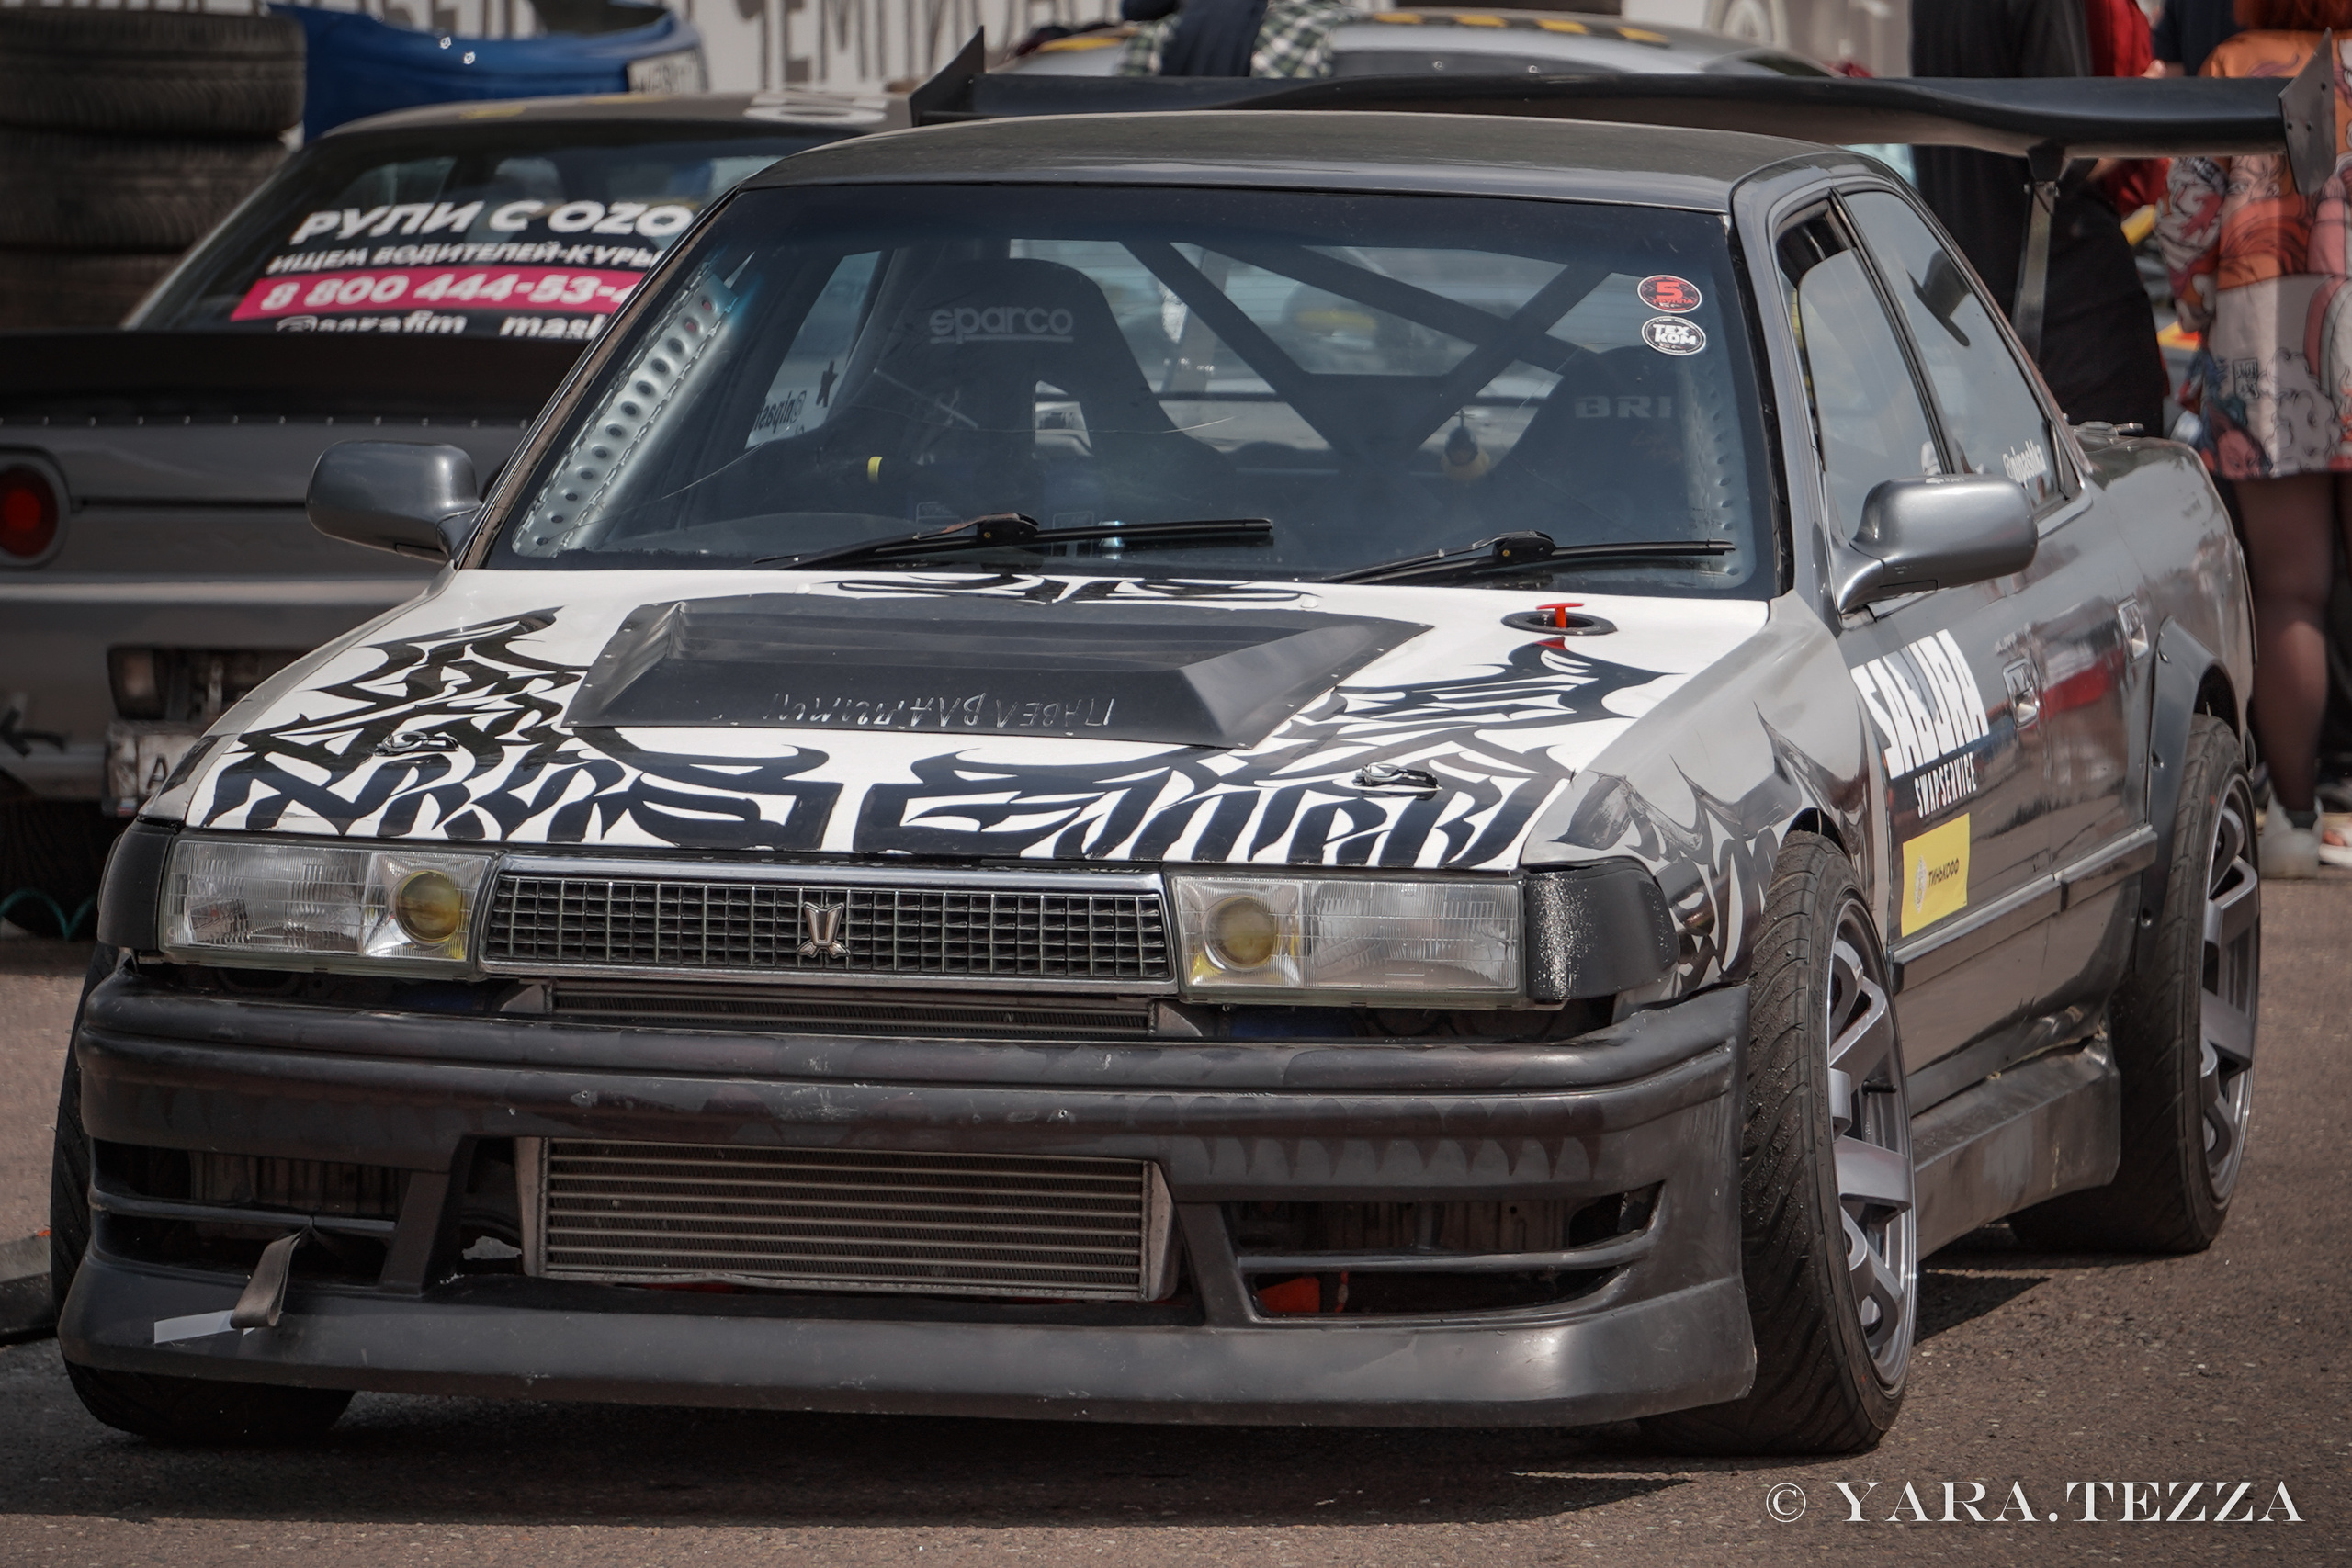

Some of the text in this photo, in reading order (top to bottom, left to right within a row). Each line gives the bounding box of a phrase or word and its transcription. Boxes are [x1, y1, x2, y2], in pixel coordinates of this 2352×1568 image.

[289, 201, 484, 245] РУЛИ
[266, 248, 368, 275] ИЩЕМ
[261, 282, 300, 310] 8
[304, 275, 410, 307] 800
[1657, 281, 1684, 301] 5
[929, 307, 1074, 344] sparco
[1652, 324, 1690, 336] ТЕХ
[1654, 333, 1696, 345] КОМ
[1575, 396, 1672, 418] BRI
[995, 697, 1115, 728] ПАВЕЛ
[1849, 628, 1990, 780] SABURA
[1914, 751, 1977, 818] SWAPSERVICE
